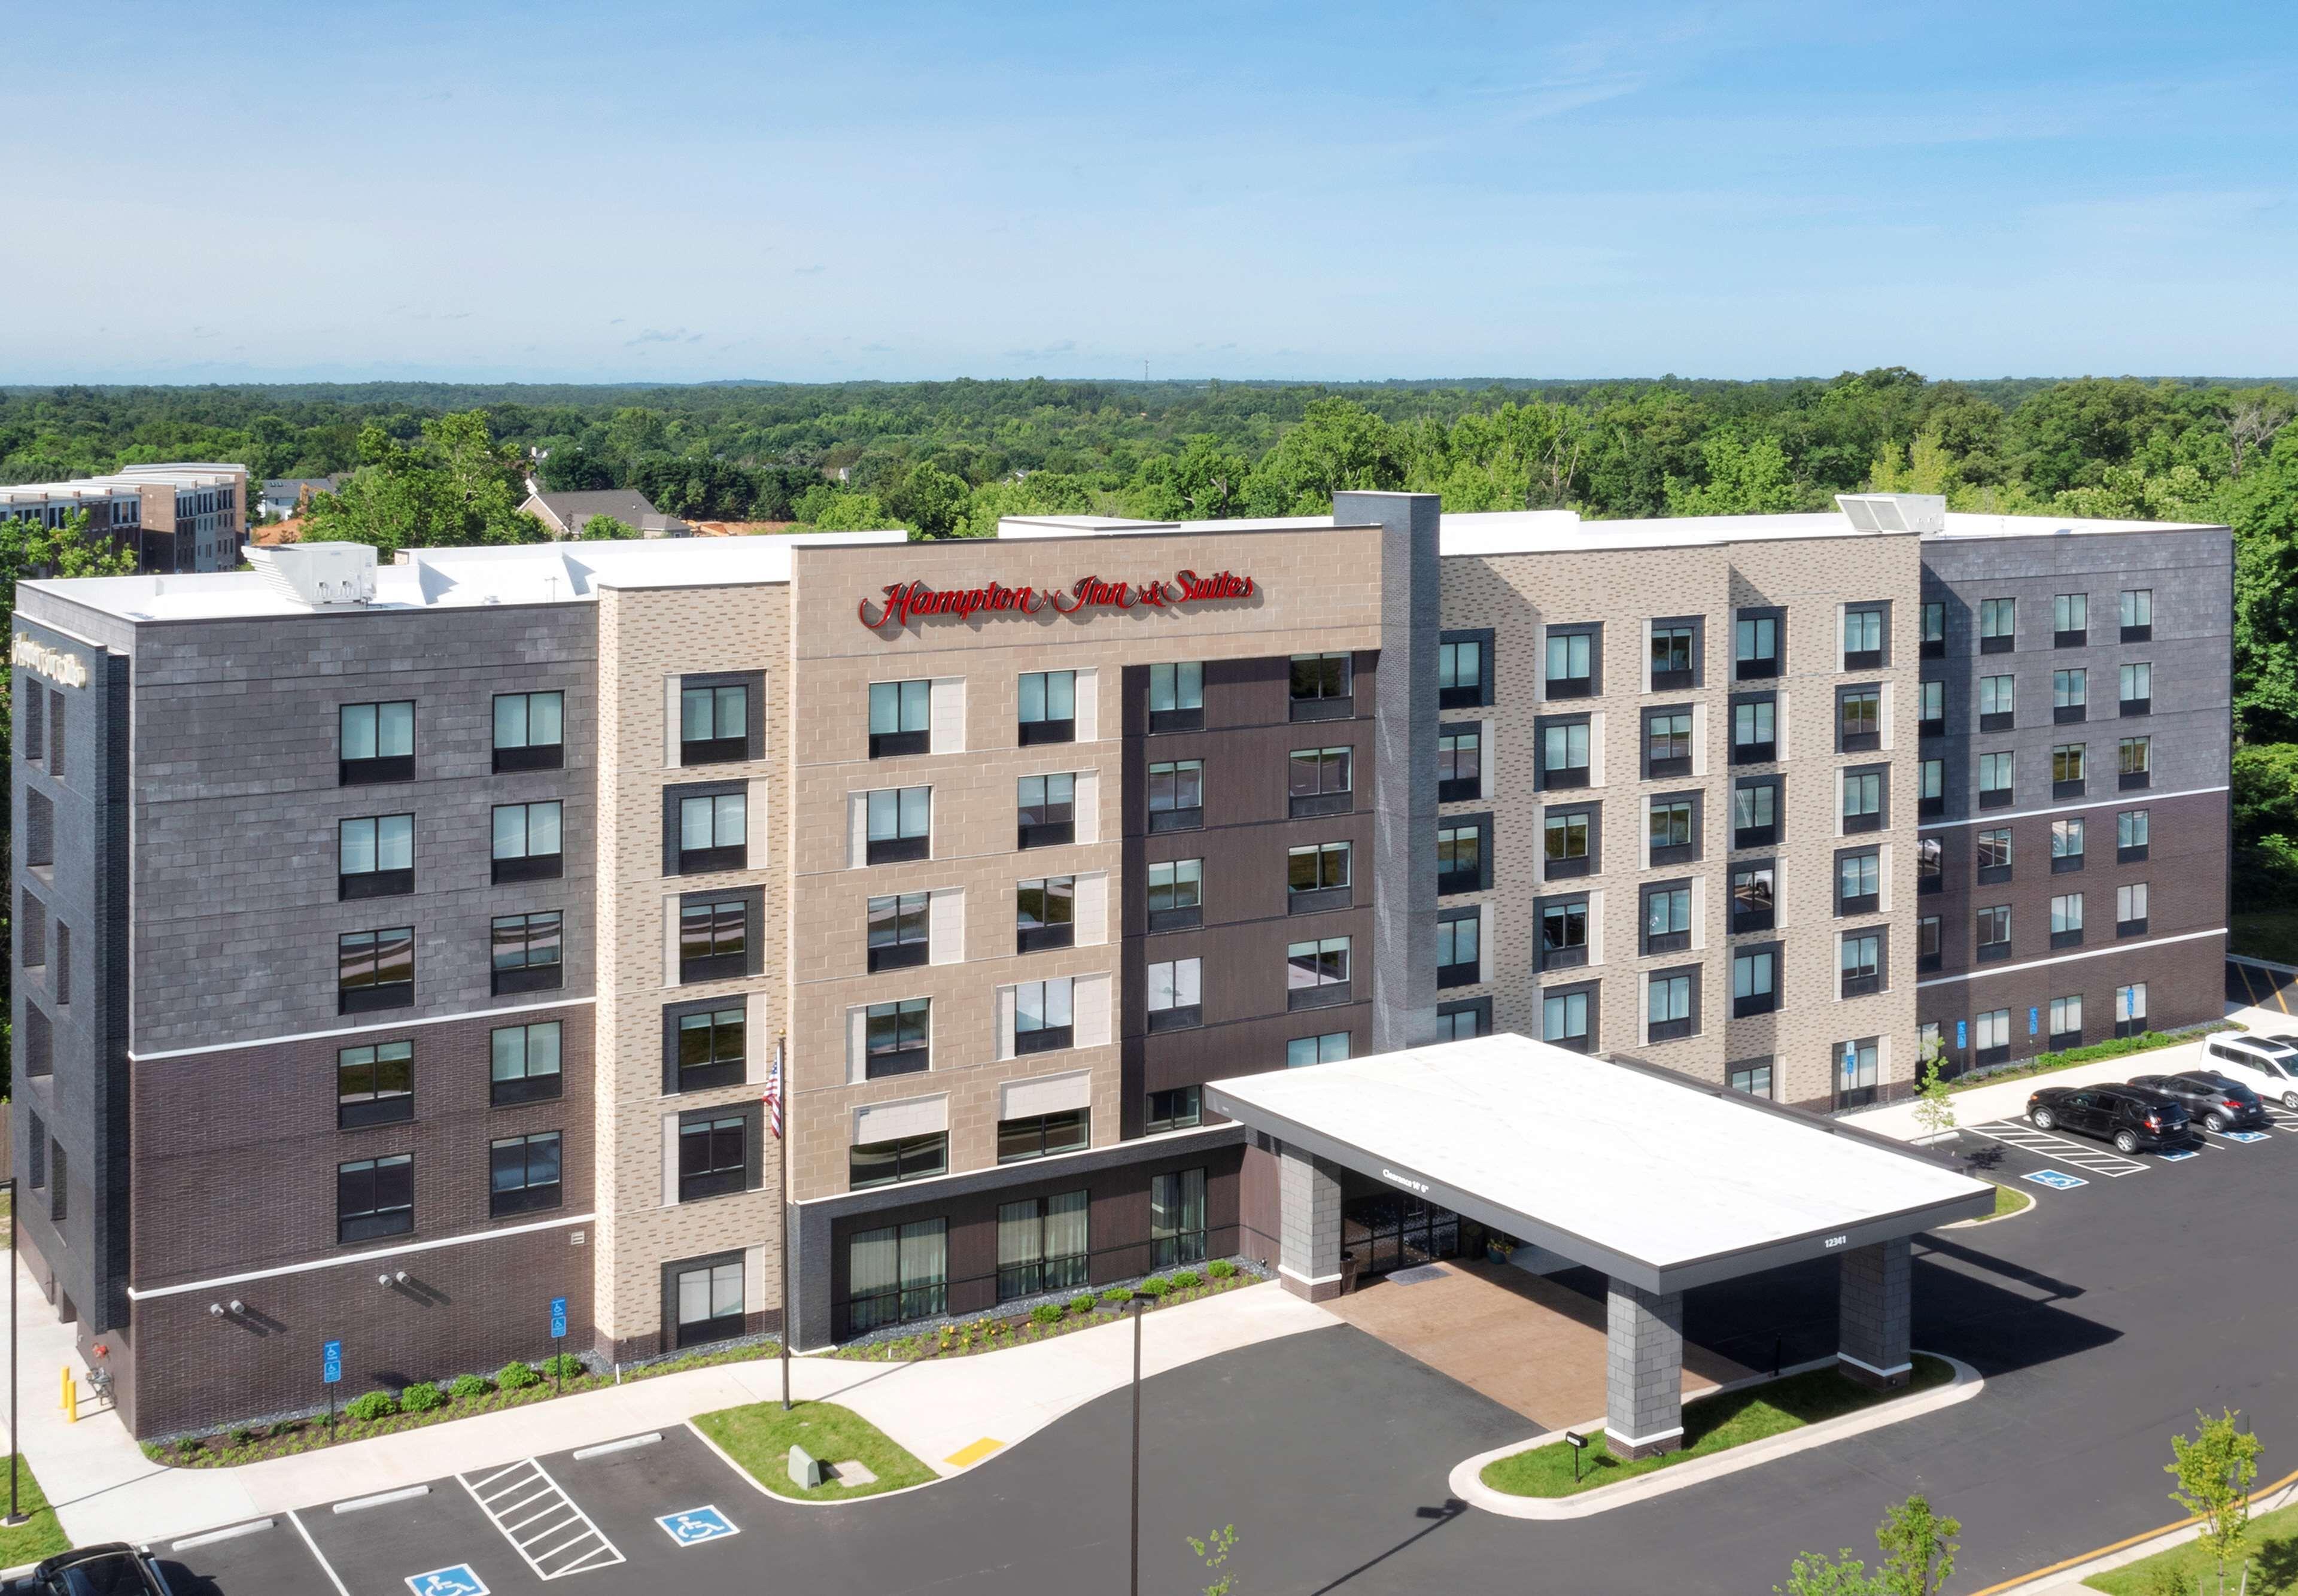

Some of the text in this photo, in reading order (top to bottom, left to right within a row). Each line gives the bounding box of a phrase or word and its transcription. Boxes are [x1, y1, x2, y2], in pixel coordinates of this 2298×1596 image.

[859, 570, 1254, 628] Hampton Inn & Suites
[1382, 1169, 1412, 1187] Clearance
[1825, 1235, 1846, 1248] 12341
